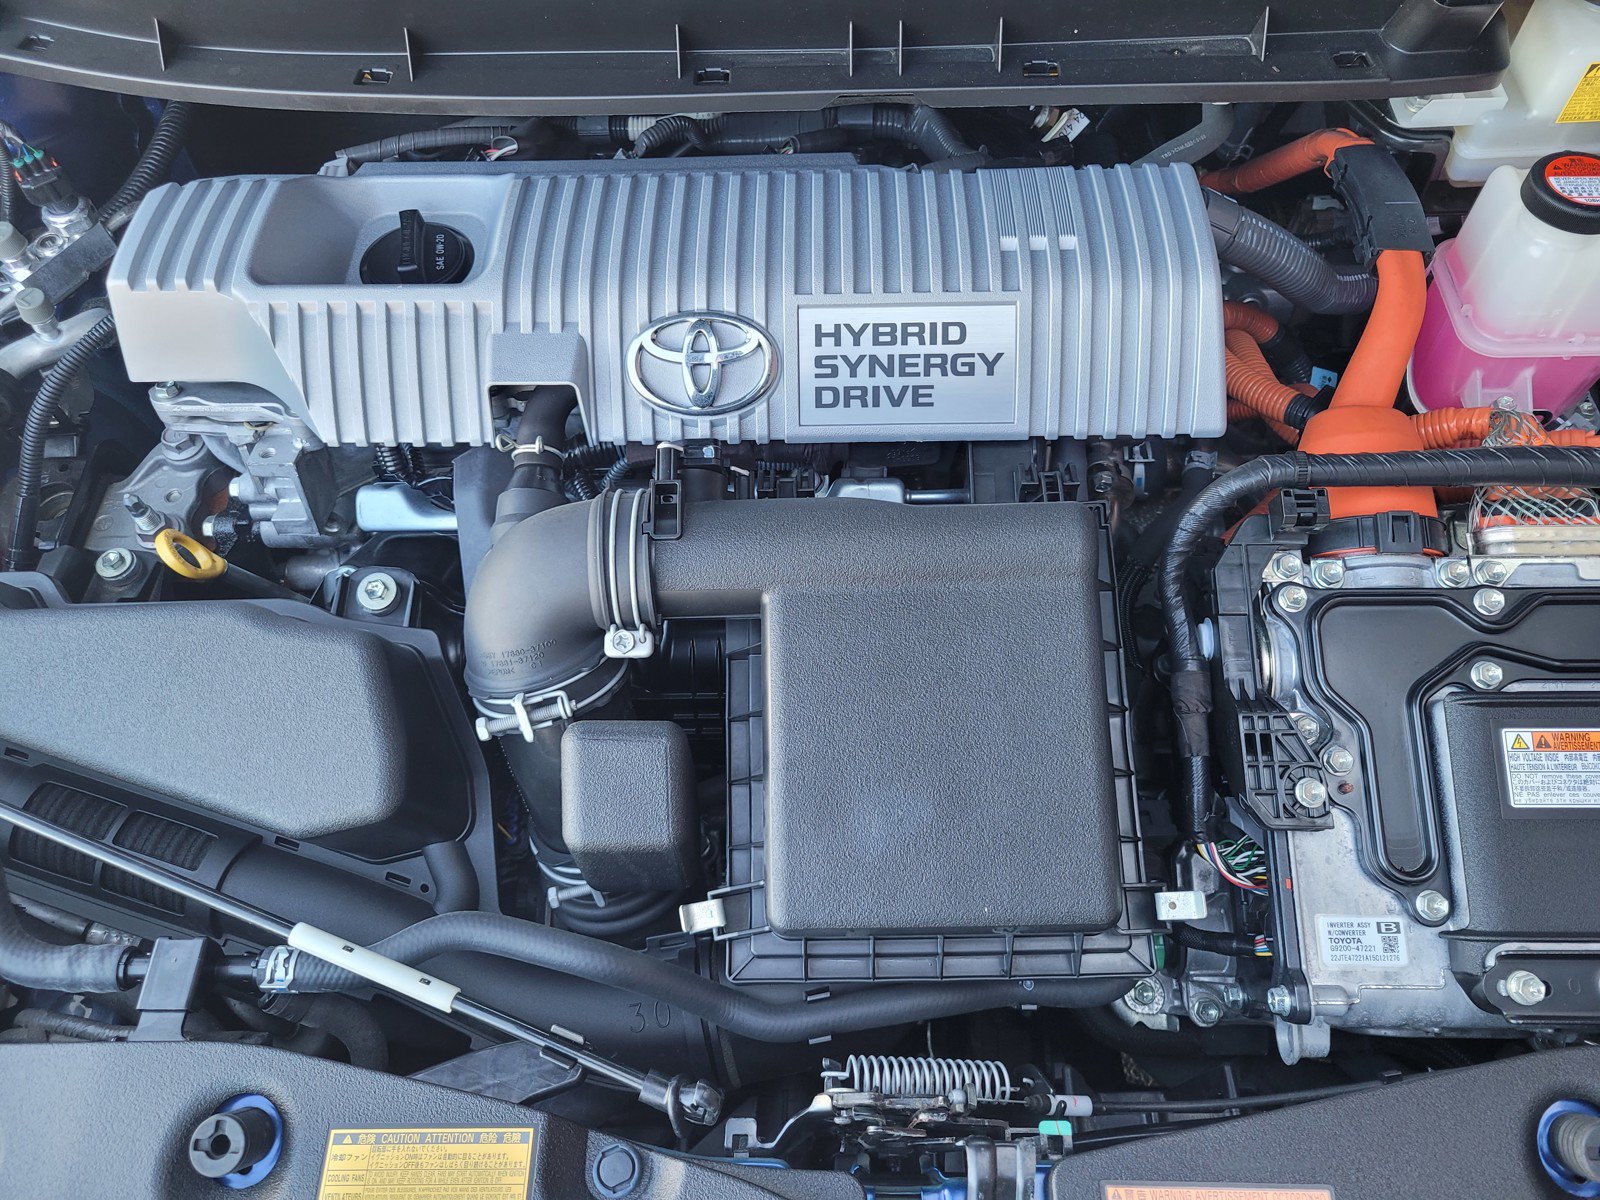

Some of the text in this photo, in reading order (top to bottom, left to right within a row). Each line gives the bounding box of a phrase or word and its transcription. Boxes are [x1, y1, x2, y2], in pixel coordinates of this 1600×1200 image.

[435, 234, 445, 271] SAE 0W-20
[814, 321, 967, 347] HYBRID
[814, 352, 1005, 378] SYNERGY
[814, 384, 935, 409] DRIVE
[1552, 732, 1591, 742] WARNING
[1552, 741, 1600, 750] AVERTISSEMENT
[1509, 753, 1560, 762] HIGH VOLTAGE INSIDE
[1326, 921, 1371, 929] INVERTER ASSY
[1380, 922, 1398, 933] B
[381, 1132, 475, 1144] CAUTION ATTENTION
[327, 1174, 365, 1183] COOLING FANS
[1149, 1190, 1269, 1200] WARNING AVERTISSEMENT
